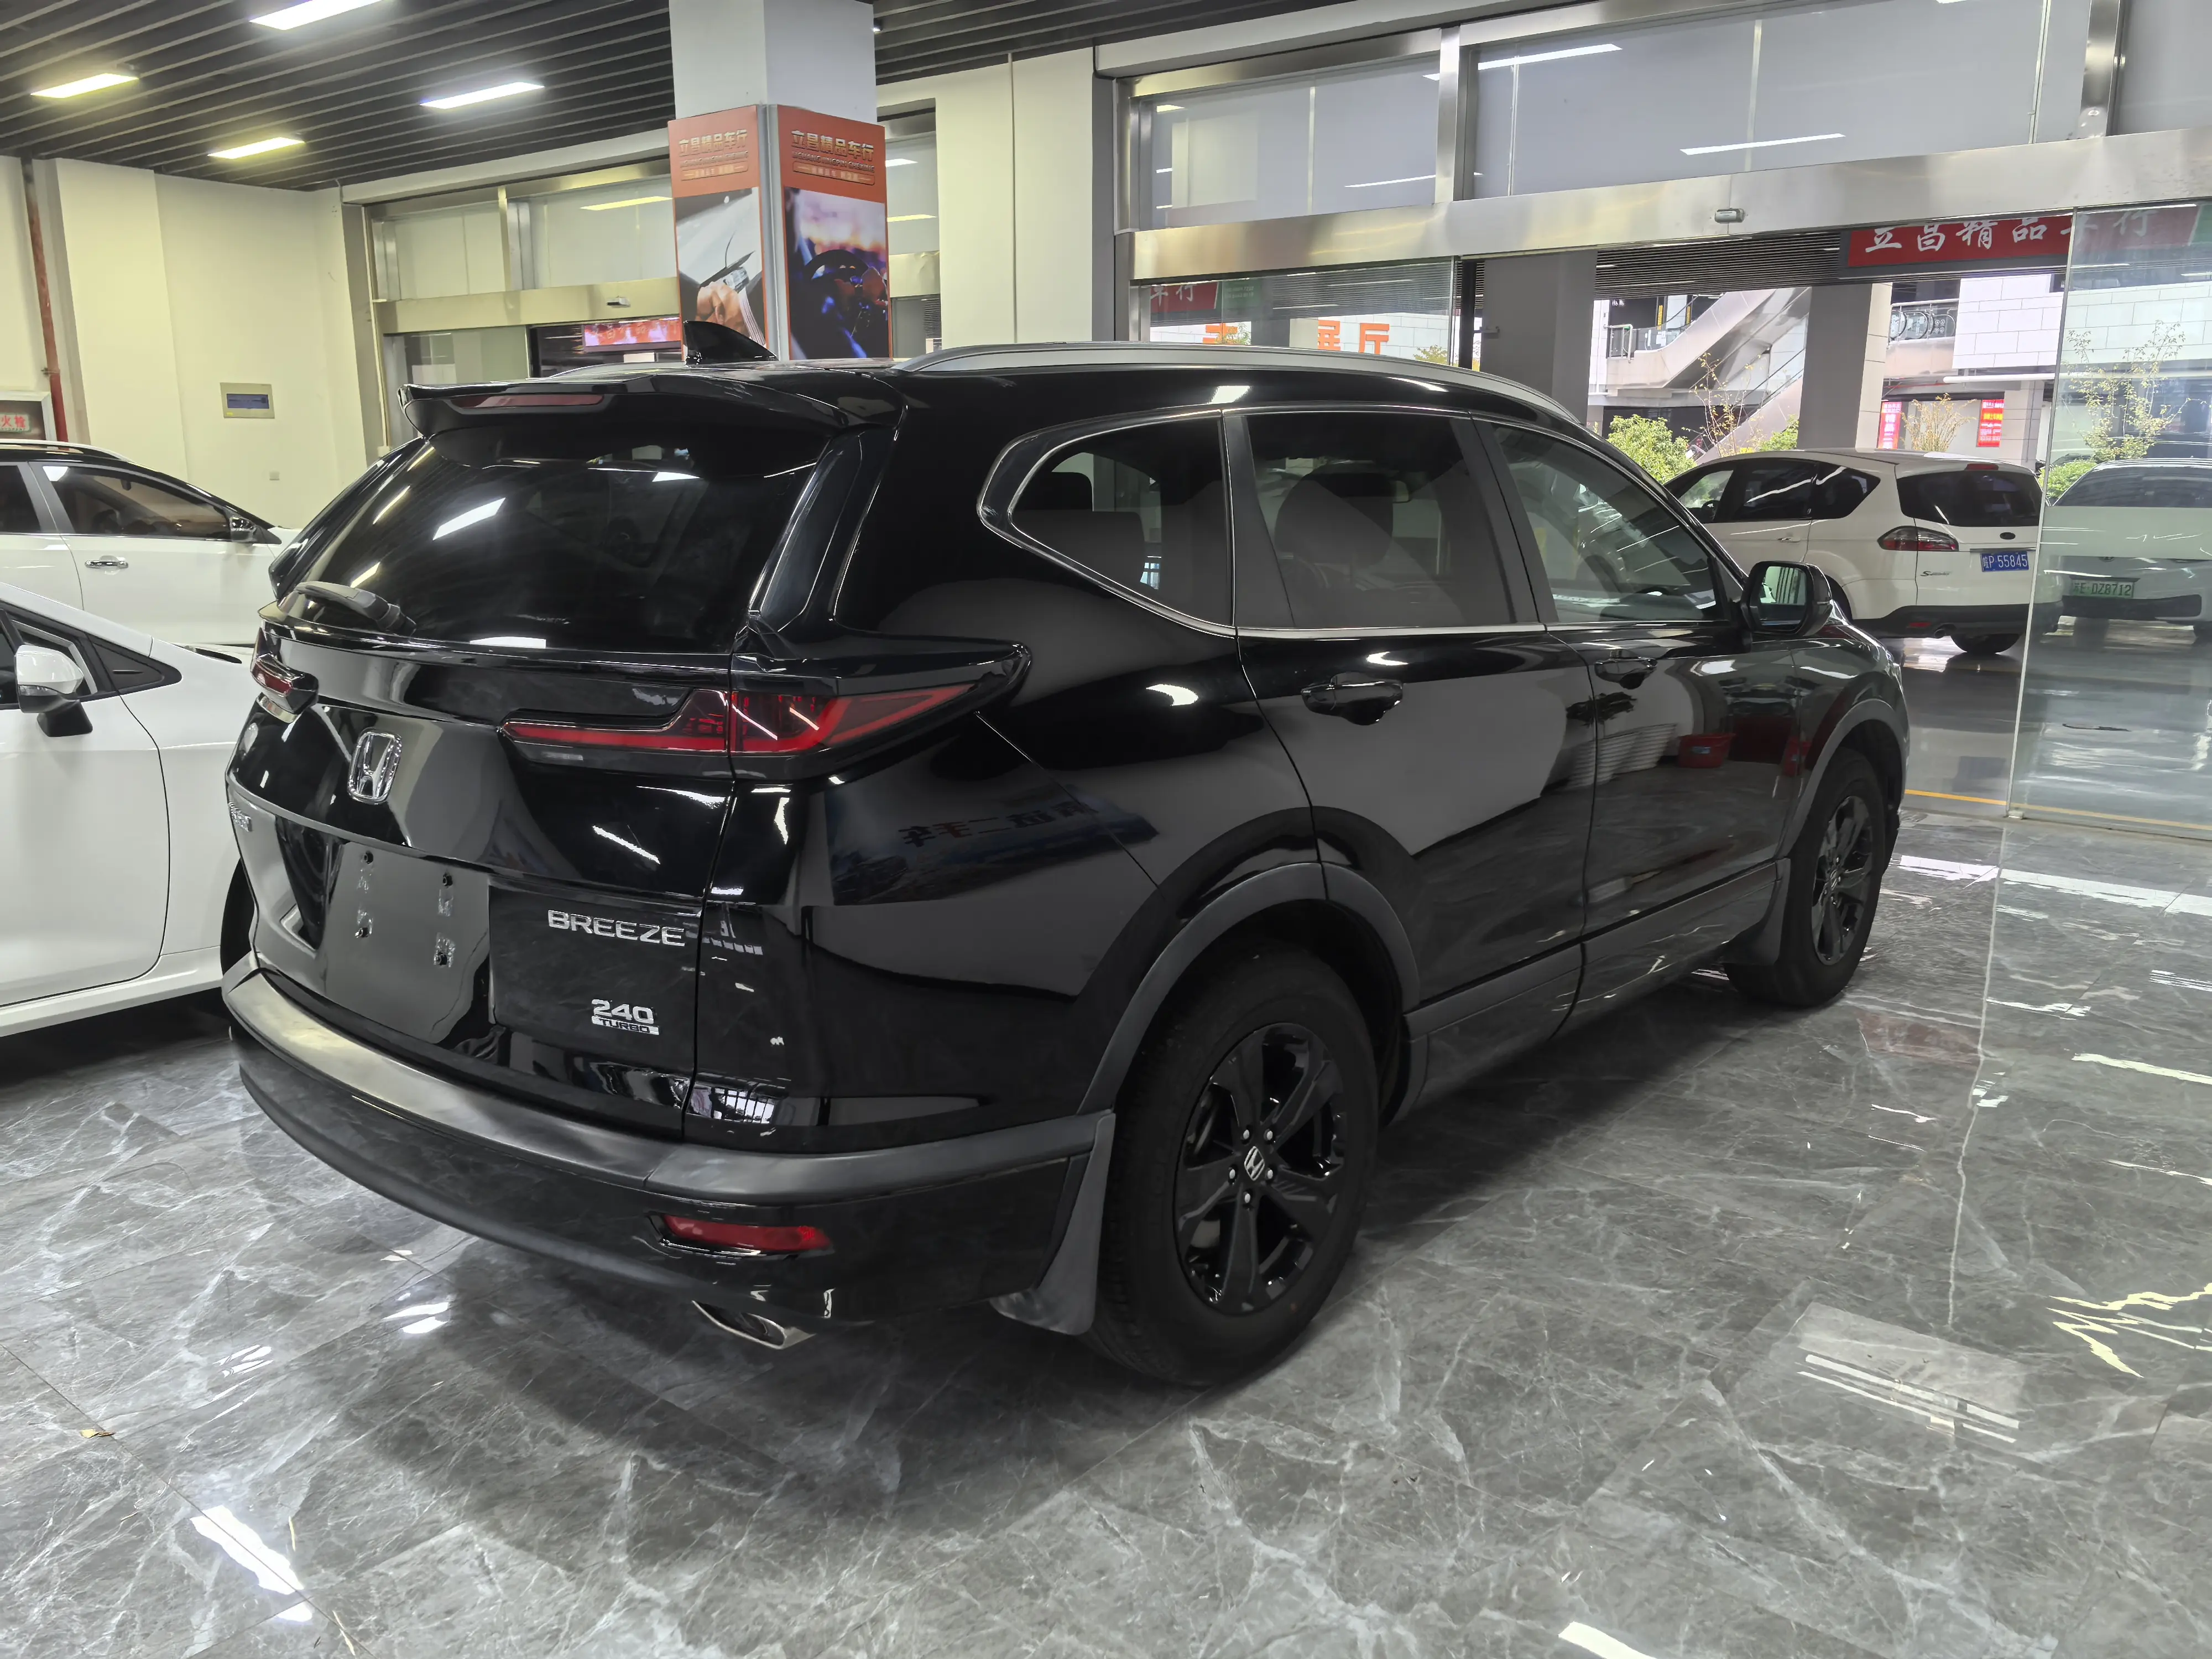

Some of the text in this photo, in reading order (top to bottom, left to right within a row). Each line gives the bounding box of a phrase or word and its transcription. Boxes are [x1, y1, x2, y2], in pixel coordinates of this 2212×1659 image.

[791, 129, 874, 161] 立昌精品车行
[547, 910, 685, 947] BREEZE
[591, 999, 655, 1024] 240
[598, 1018, 651, 1034] TURBO
